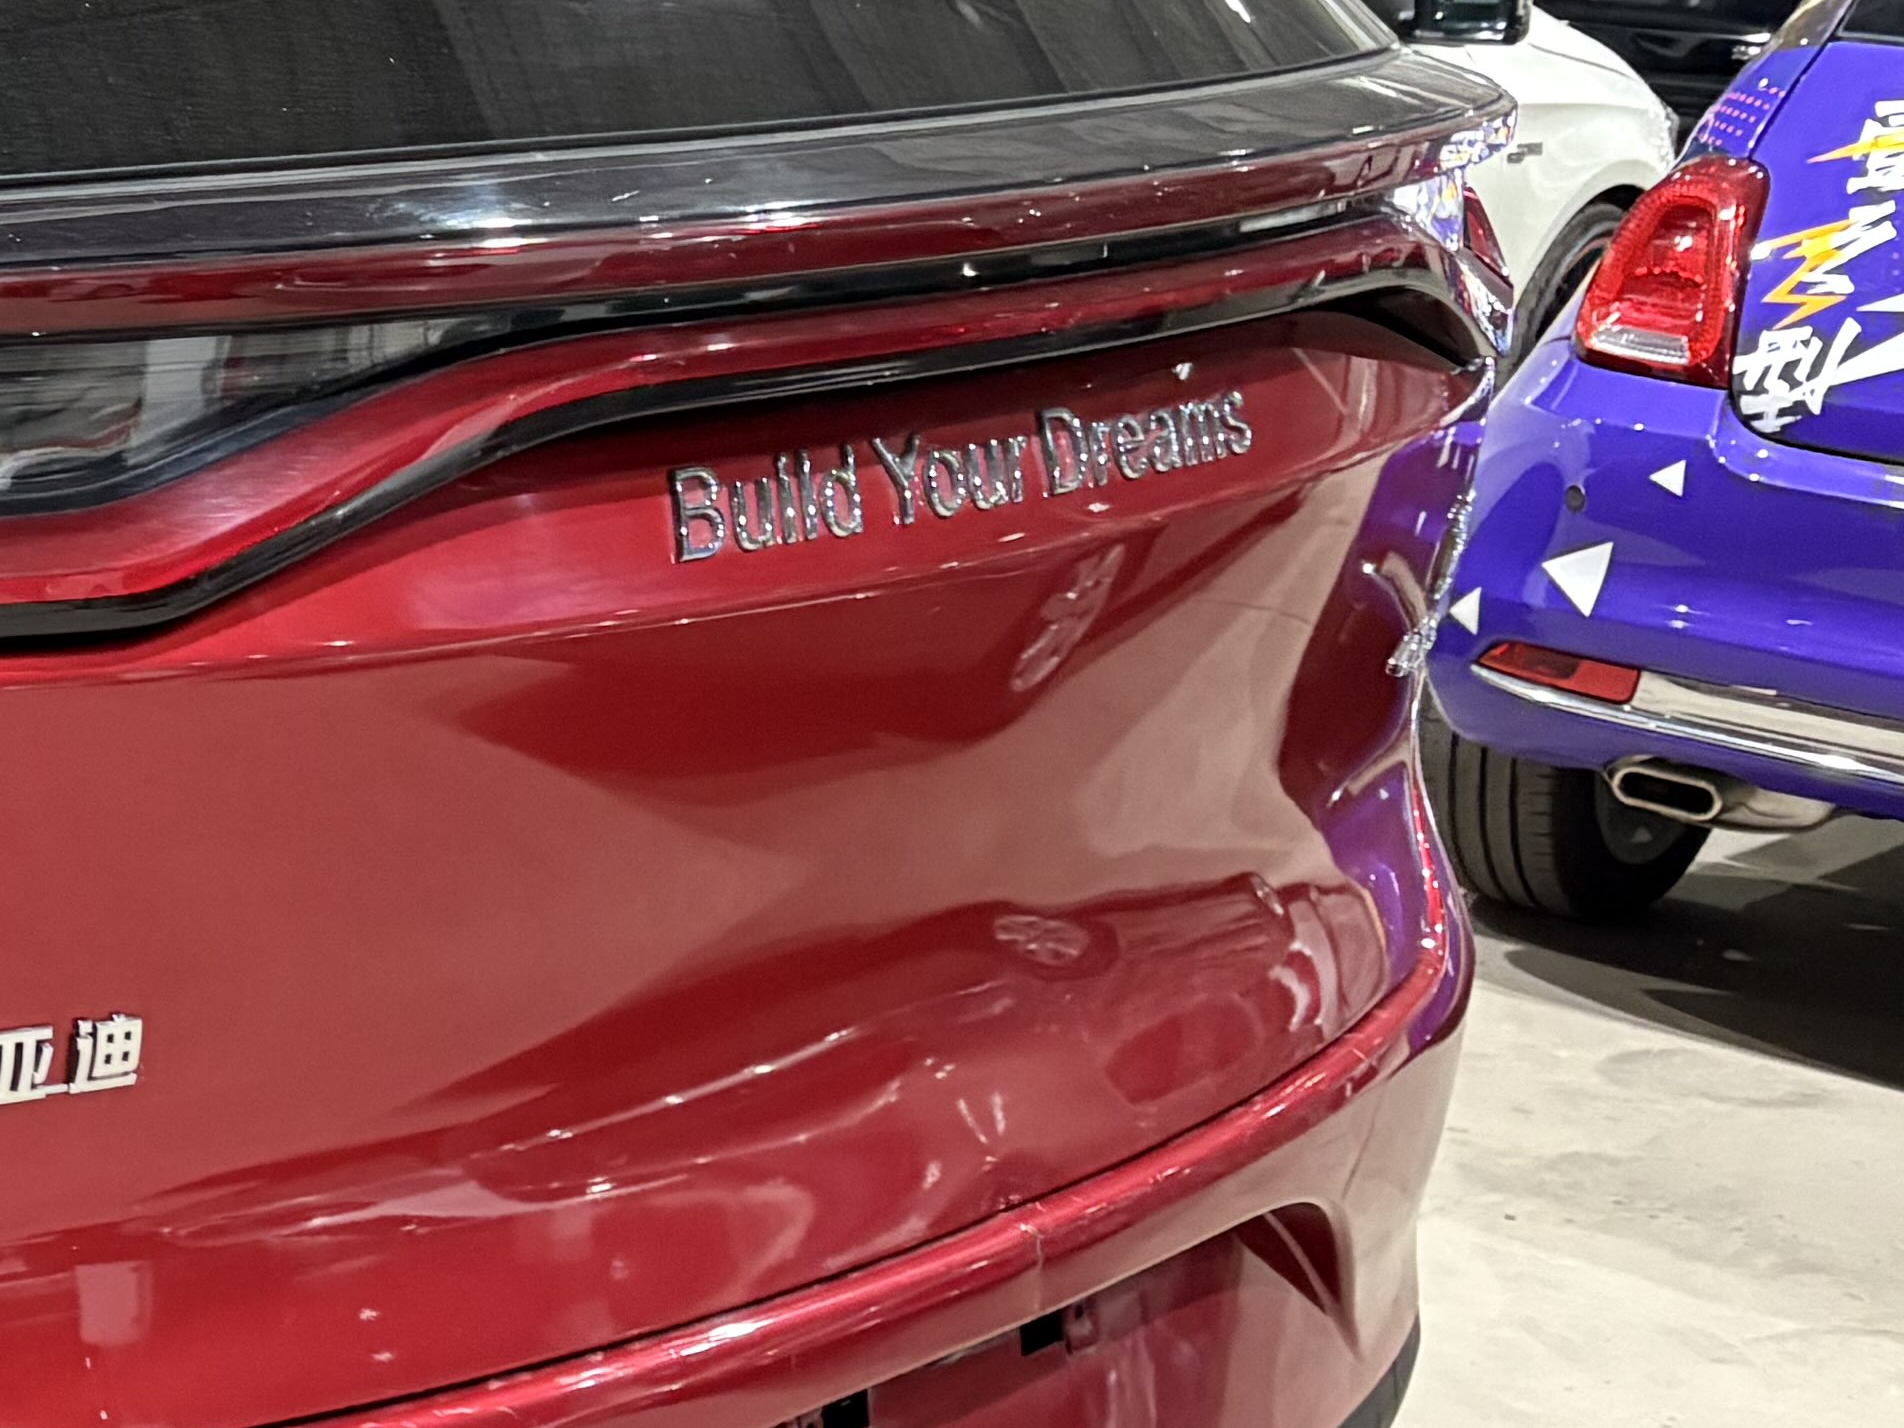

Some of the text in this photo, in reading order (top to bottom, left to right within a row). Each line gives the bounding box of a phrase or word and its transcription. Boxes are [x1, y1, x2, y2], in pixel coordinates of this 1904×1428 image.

[670, 390, 1254, 564] Build Your Dreams
